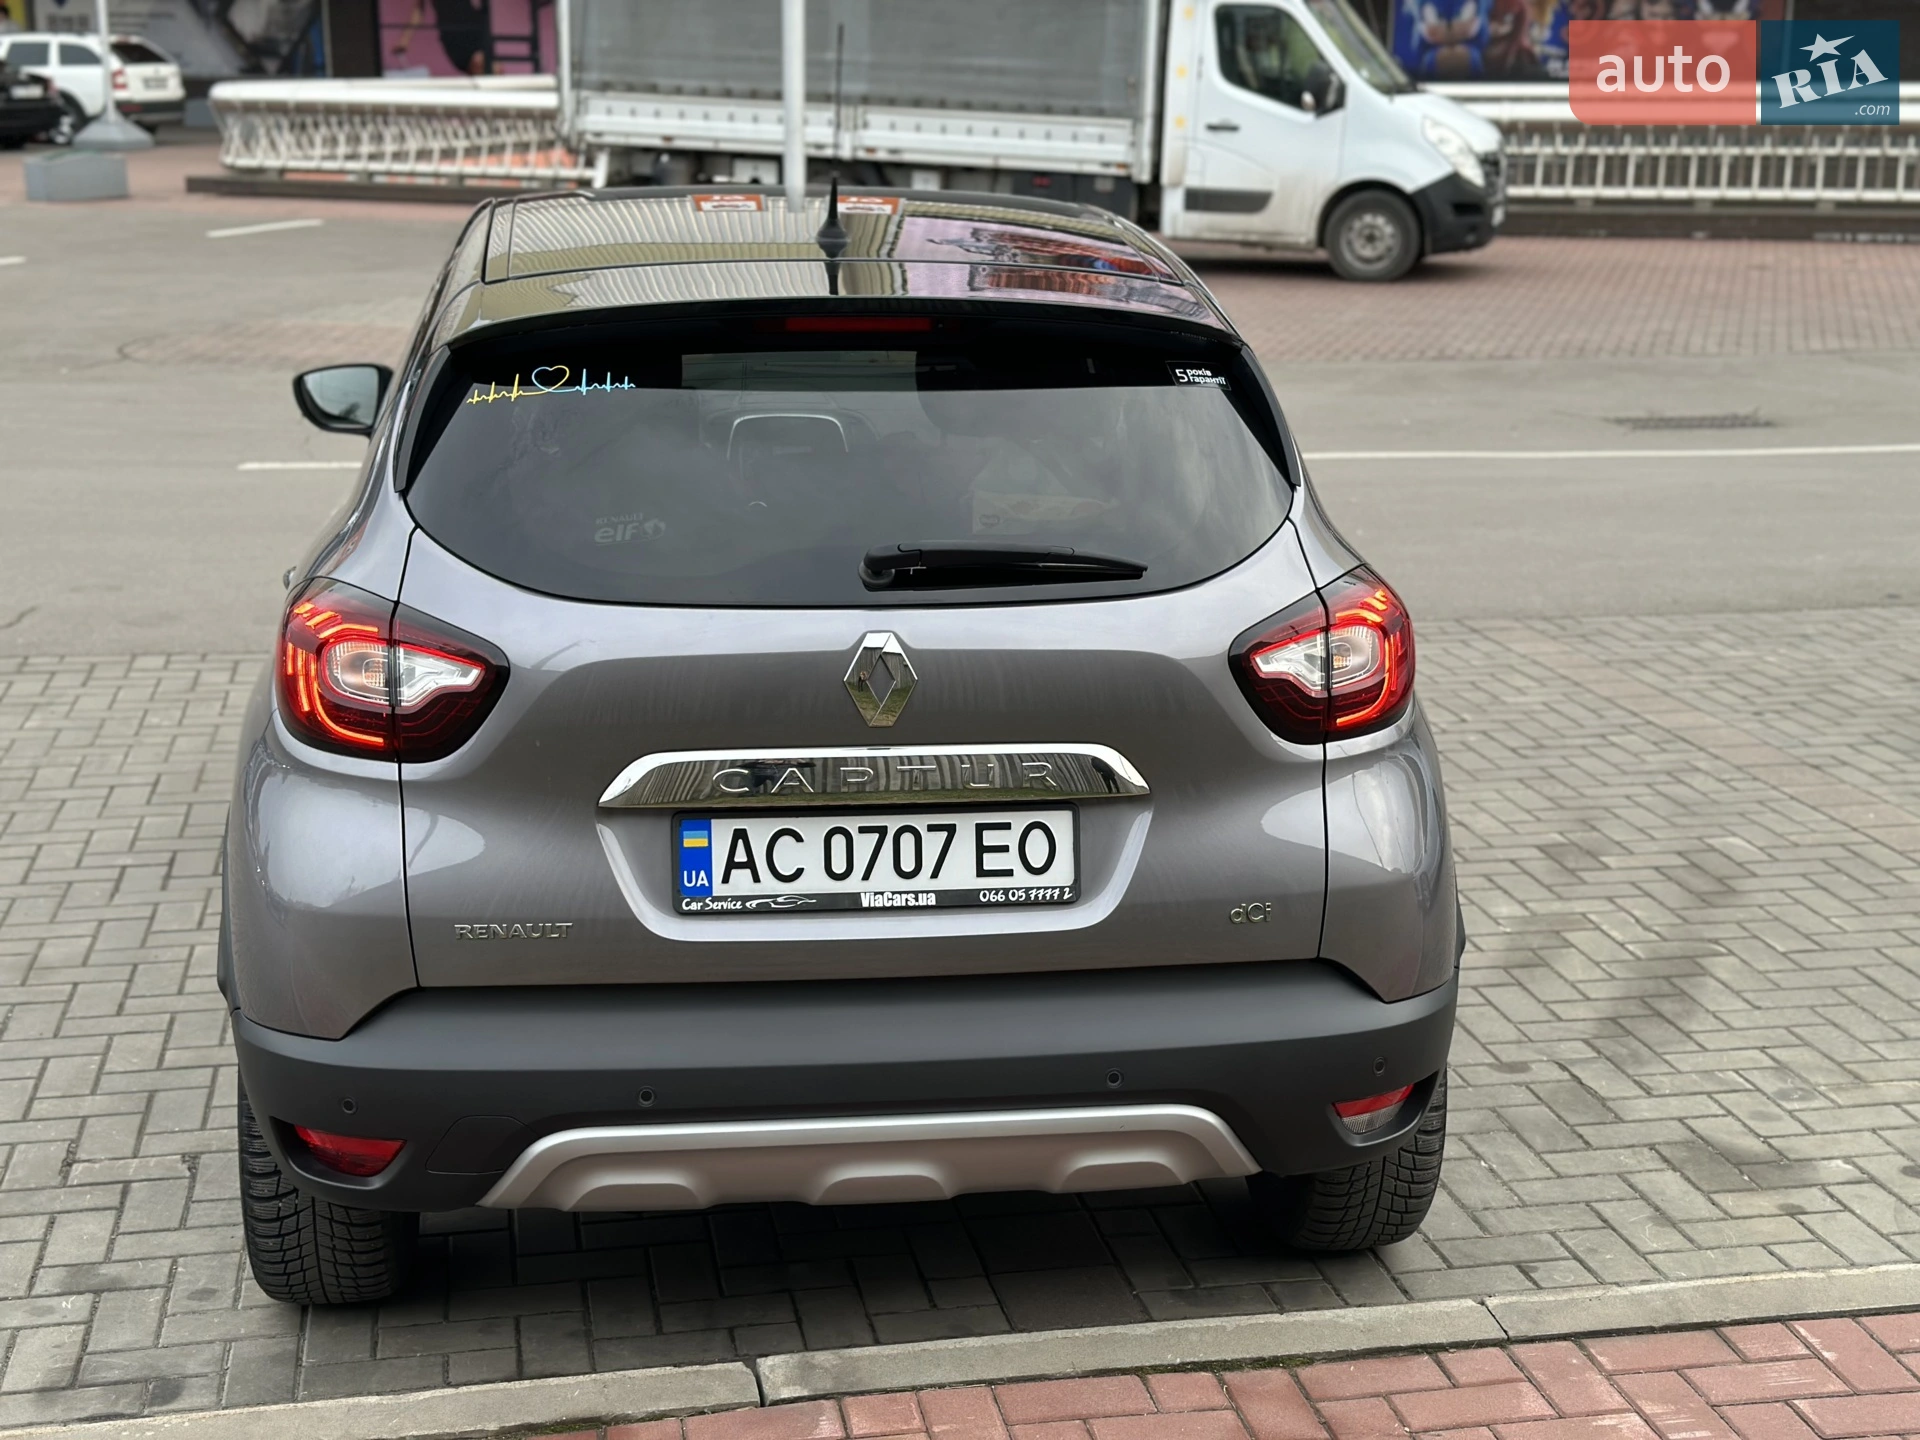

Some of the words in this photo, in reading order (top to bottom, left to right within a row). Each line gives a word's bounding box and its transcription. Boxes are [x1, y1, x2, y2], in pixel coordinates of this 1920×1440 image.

[1175, 368, 1189, 383] 5
[711, 761, 1059, 793] CAPTUR
[721, 827, 805, 884] AC
[823, 822, 957, 882] 0707
[974, 820, 1057, 878] EO
[682, 869, 710, 888] UA
[681, 897, 703, 911] Car
[704, 897, 743, 911] Service
[860, 891, 936, 908] ViaCars.ua
[979, 889, 1006, 903] 066
[1008, 888, 1026, 902] 05
[1063, 887, 1073, 900] 2
[1230, 902, 1272, 923] dCi
[454, 922, 573, 940] RENAULT
